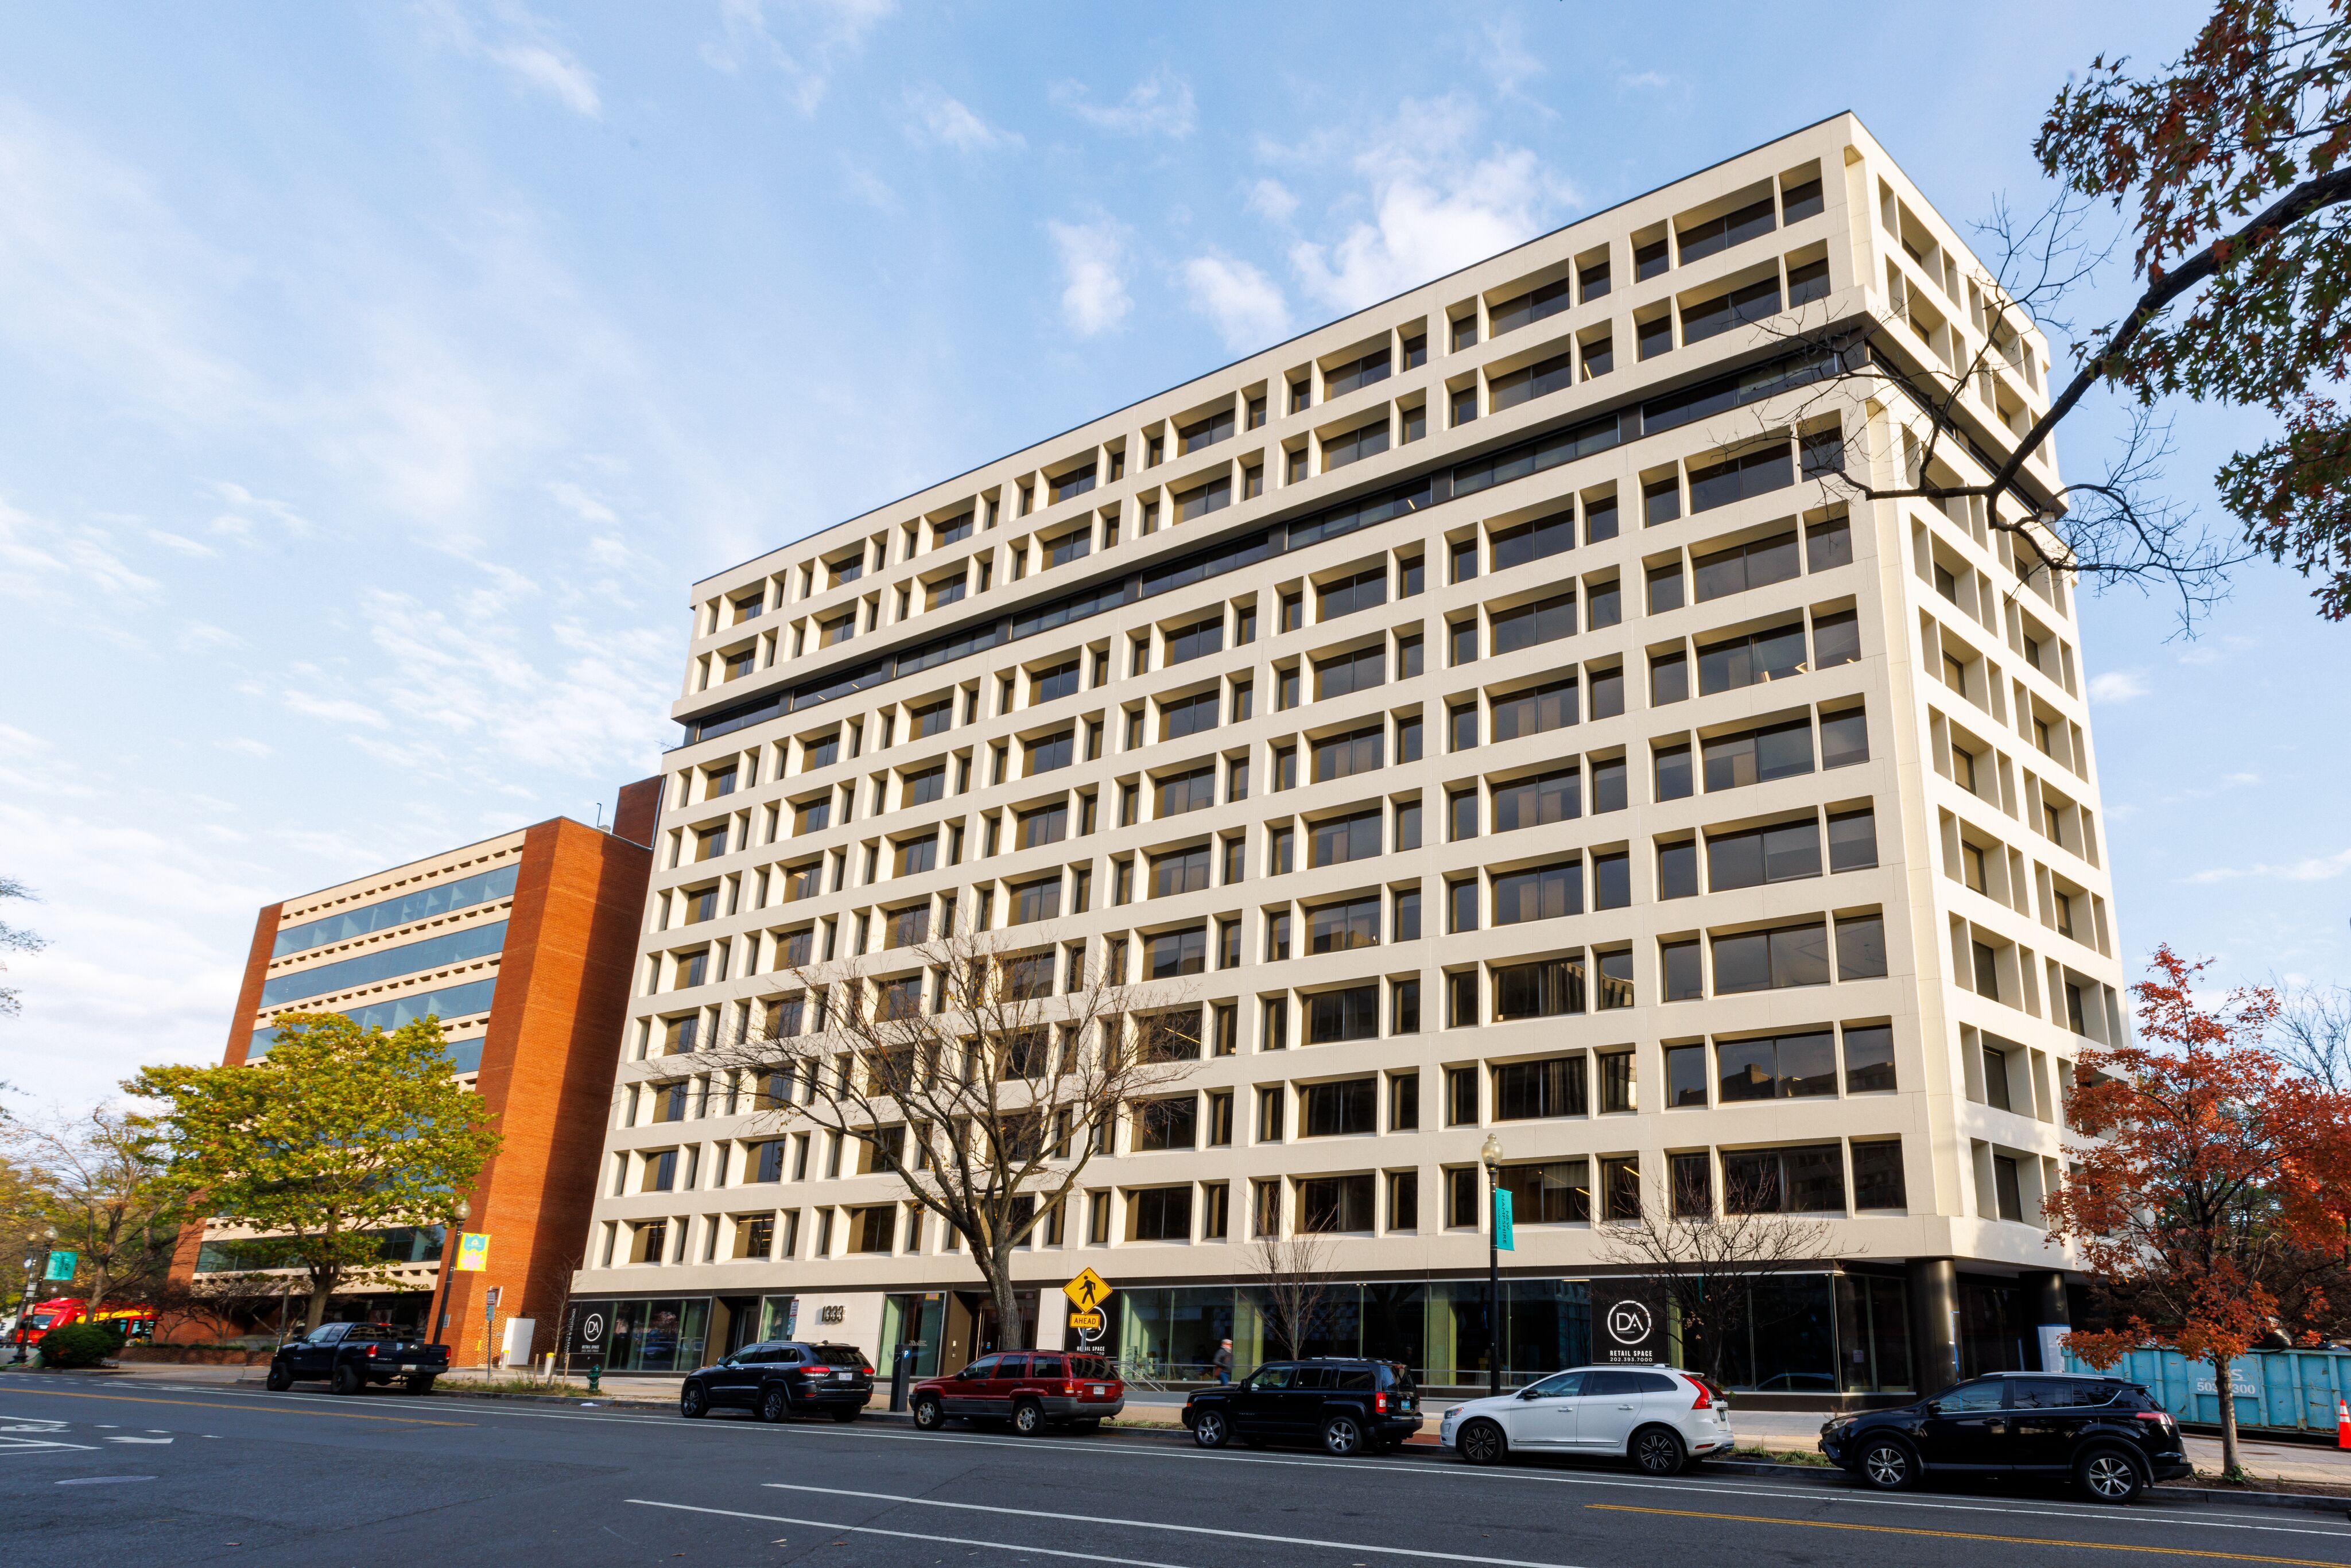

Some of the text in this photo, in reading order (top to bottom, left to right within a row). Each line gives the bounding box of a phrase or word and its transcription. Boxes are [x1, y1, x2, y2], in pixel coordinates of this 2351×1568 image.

[822, 1305, 844, 1322] 1333
[1616, 1312, 1644, 1331] DA
[587, 1321, 599, 1333] DA
